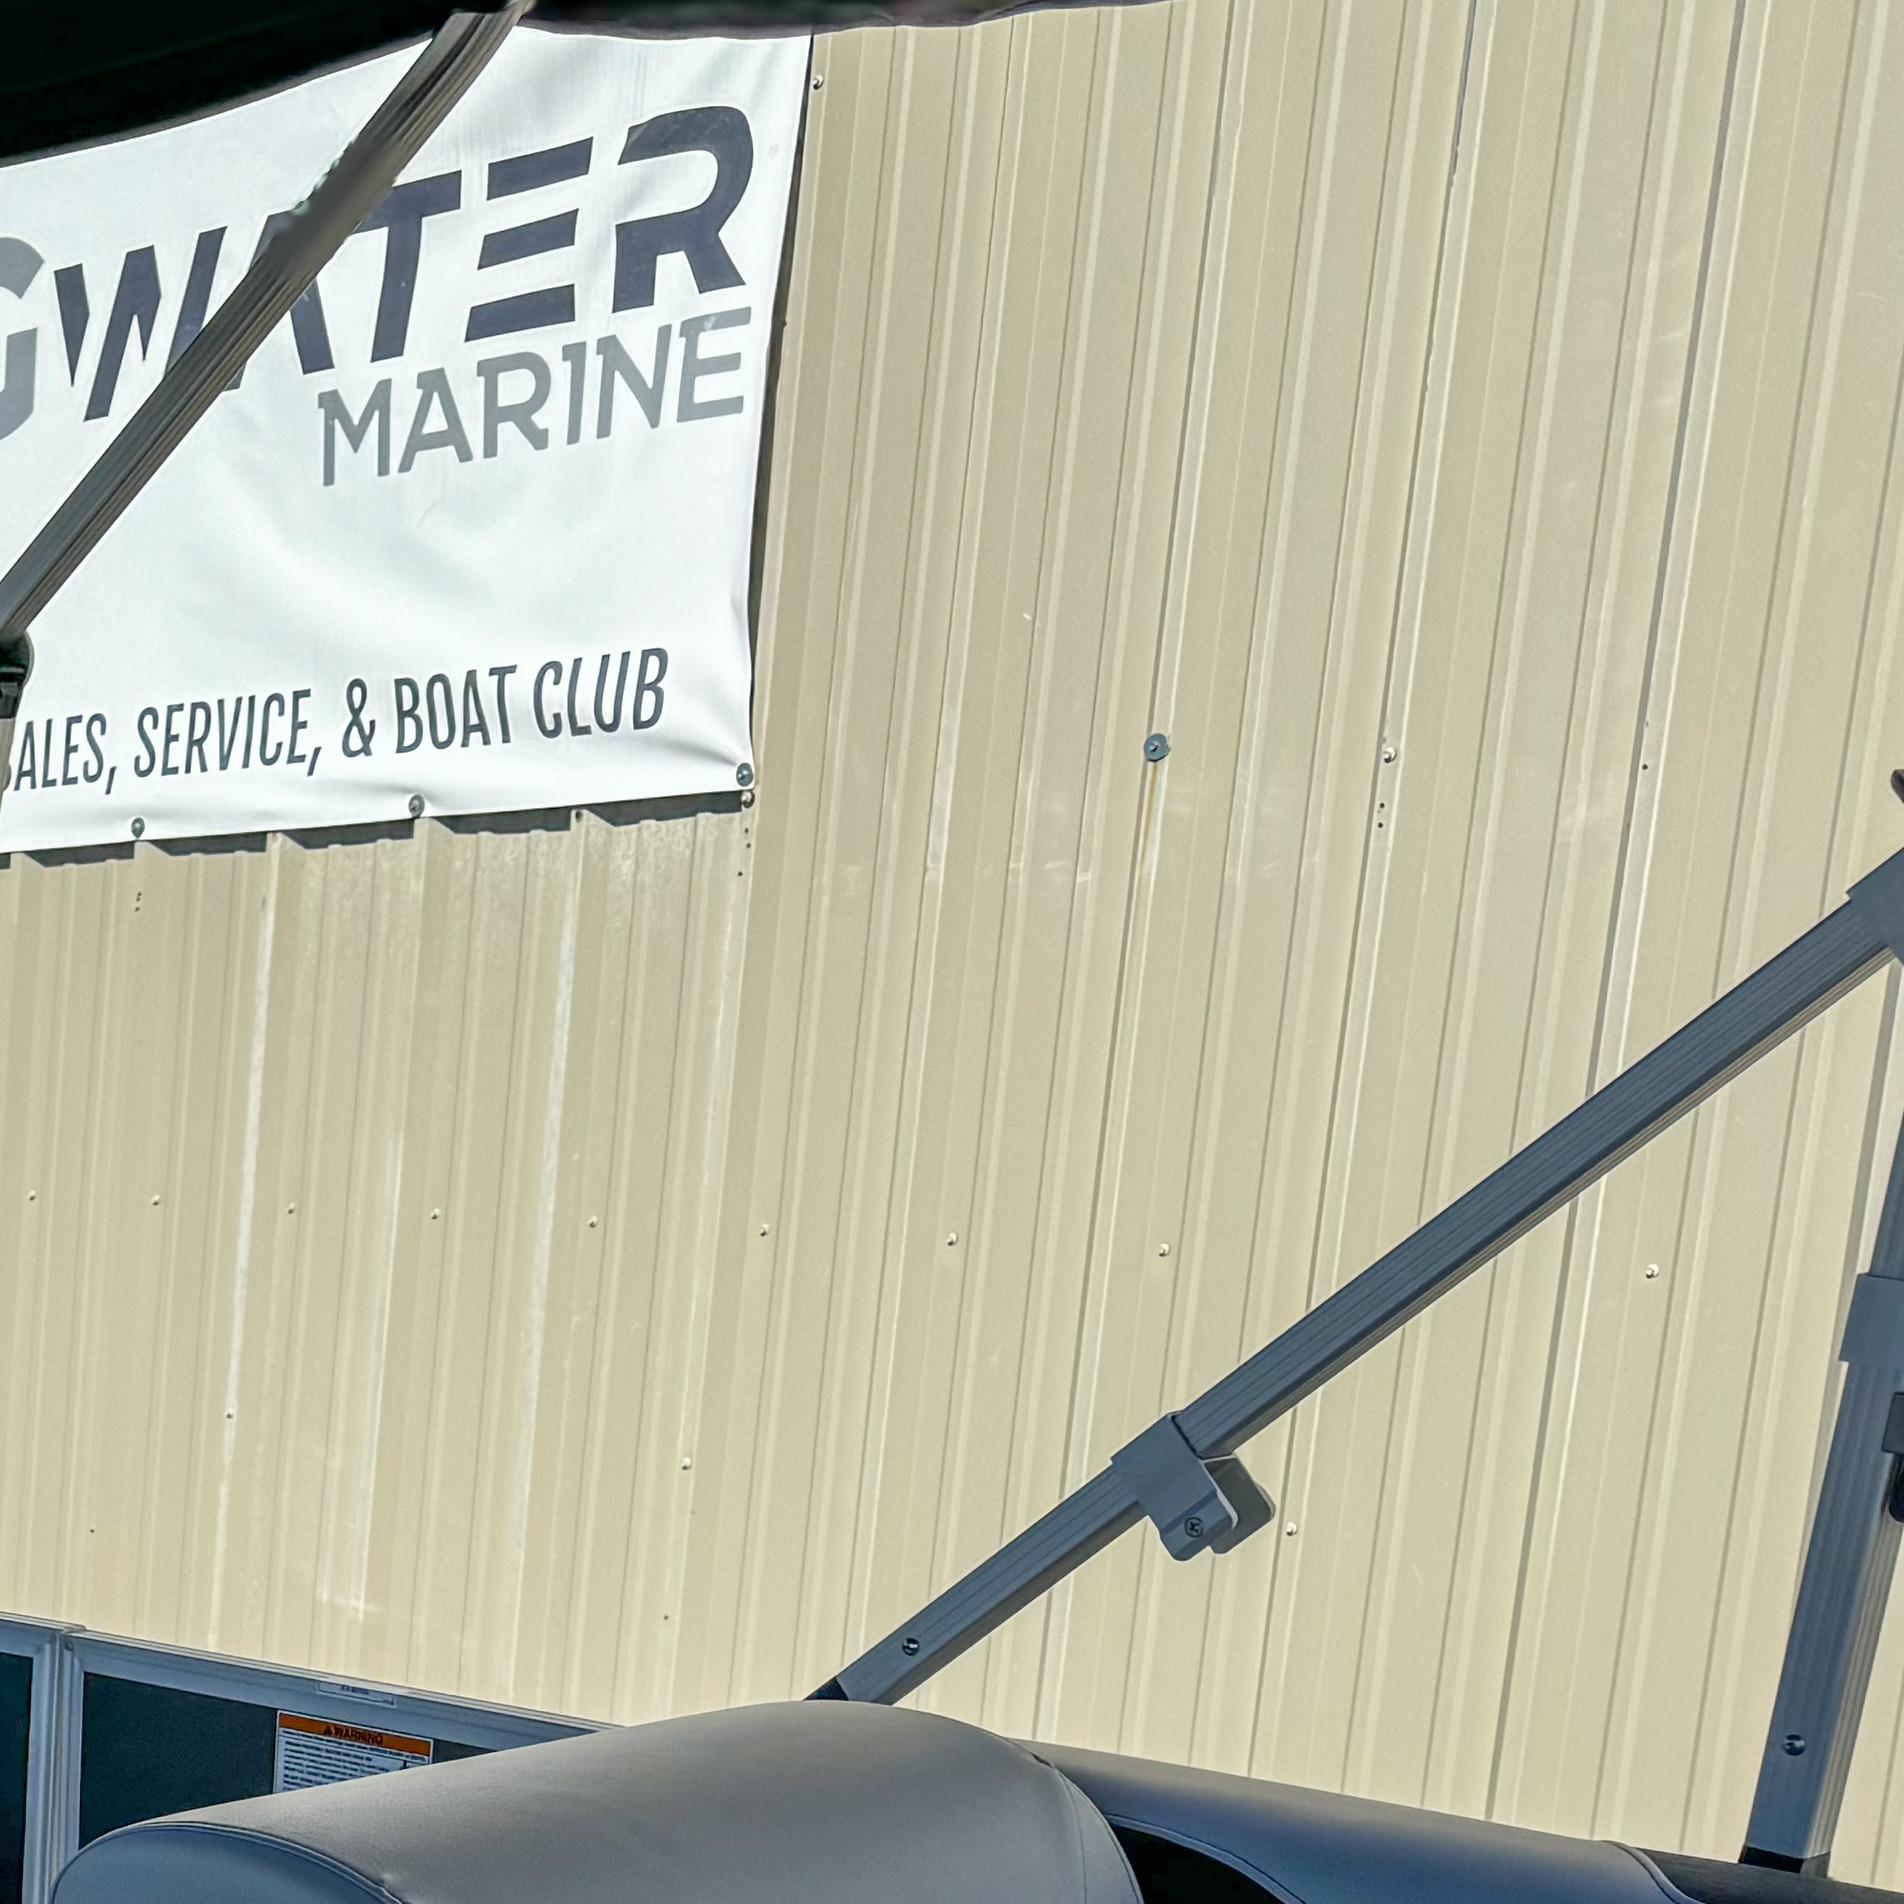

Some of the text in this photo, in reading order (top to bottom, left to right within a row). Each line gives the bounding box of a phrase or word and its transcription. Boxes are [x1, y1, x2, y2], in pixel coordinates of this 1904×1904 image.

[317, 306, 753, 488] MARINE
[4, 712, 117, 796] ALES,
[134, 688, 322, 777] SERVICE,
[341, 677, 376, 758] &
[394, 664, 518, 755] BOAT
[533, 647, 669, 740] CLUB
